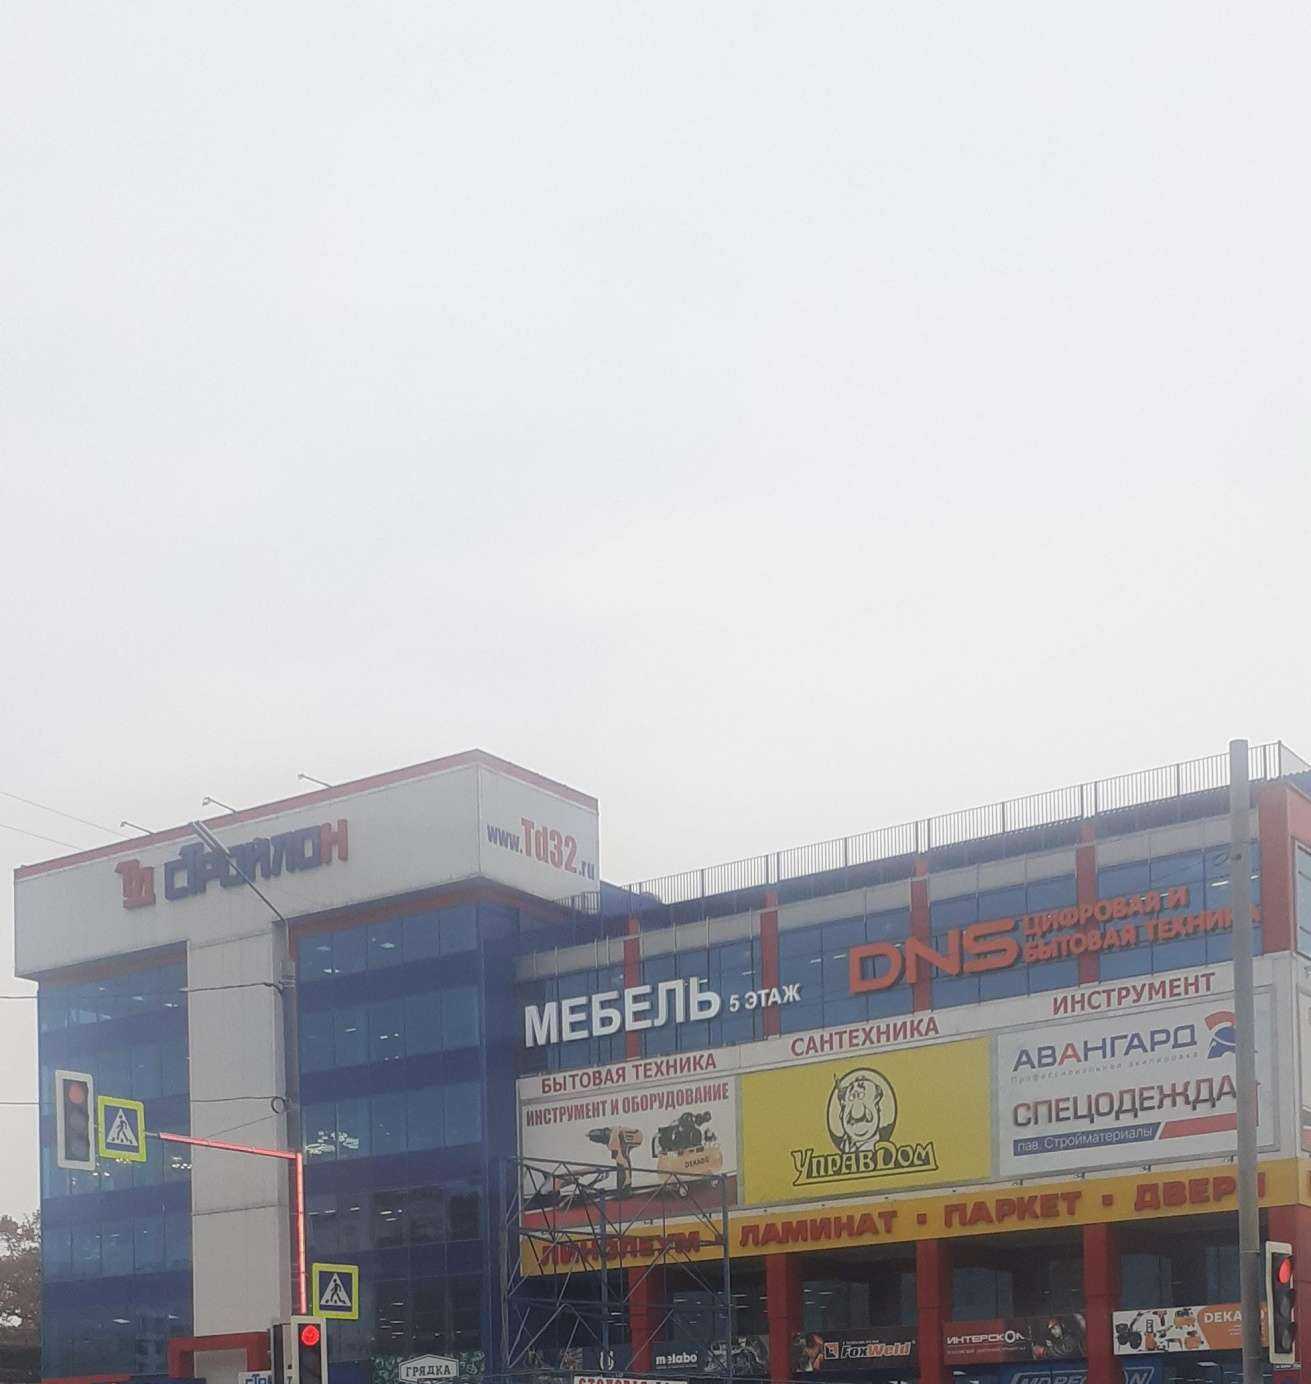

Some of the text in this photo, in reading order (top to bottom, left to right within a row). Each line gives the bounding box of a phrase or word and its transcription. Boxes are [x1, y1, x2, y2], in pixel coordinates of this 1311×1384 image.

[486, 817, 595, 880] www.Td32.ru
[1023, 886, 1189, 937] ЦИФРОВАЯ И
[849, 918, 1019, 995] DNS
[1023, 923, 1137, 963] БЫТОВАЯ
[525, 977, 801, 1047] МЕБЕЛЬ 5 ЭТАЖ
[1052, 972, 1216, 1016] ИНСТРУМЕНТ
[791, 1017, 940, 1056] САНТЕХНИКА
[1012, 1024, 1197, 1072] АВАНГАРД
[541, 1053, 717, 1094] БЫТОВАЯ ТЕХНИКА
[526, 1082, 729, 1127] ИНСТРУМЕНТ И ОБОРУДОВАНИЕ
[1013, 1074, 1237, 1127] СПЕЦОДЕЖДА
[1044, 1127, 1153, 1149] Стройматериалы
[739, 1211, 898, 1248] ЛАМИНАТ
[944, 1191, 1082, 1228] ПАРКЕТ
[406, 1365, 451, 1377] ГРЯДКА
